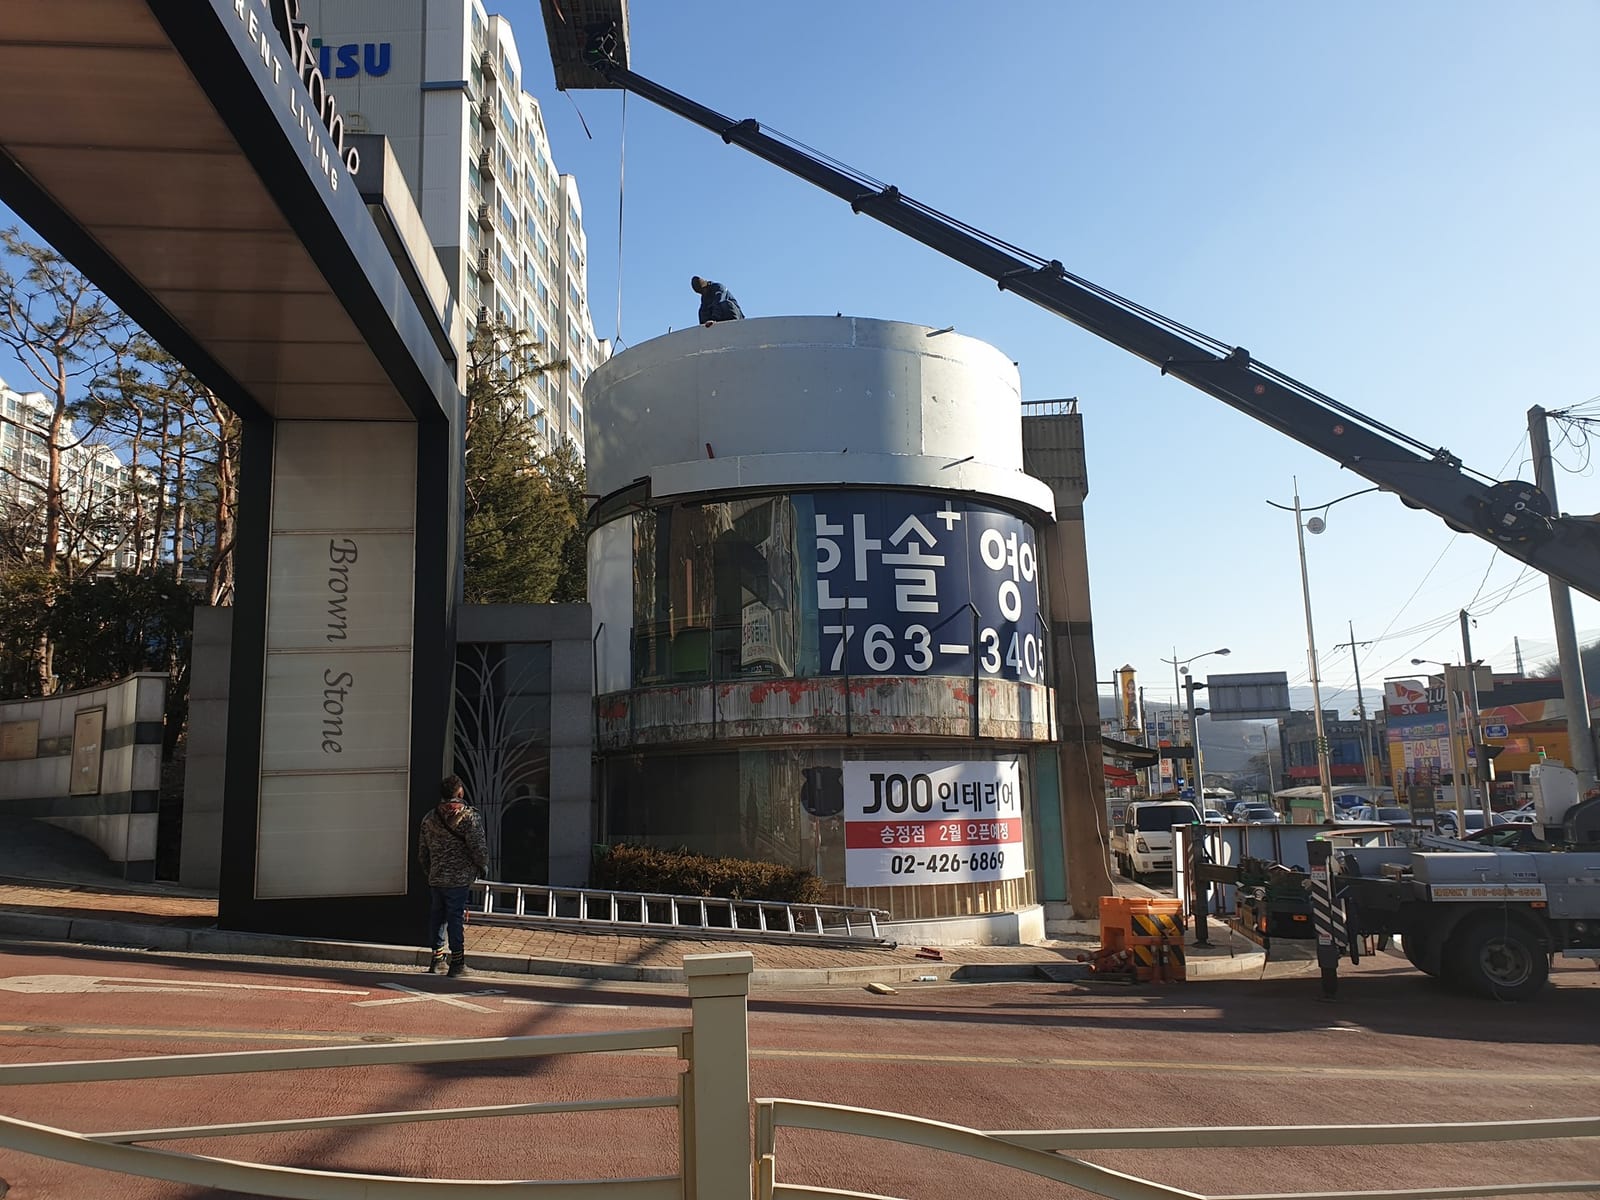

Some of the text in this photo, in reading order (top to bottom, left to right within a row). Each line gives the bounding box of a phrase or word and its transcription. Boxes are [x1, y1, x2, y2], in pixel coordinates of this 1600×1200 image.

[318, 42, 391, 80] ISU
[290, 87, 339, 192] LIVING
[321, 538, 359, 754] Brown Stone
[822, 623, 1046, 681] 763-3405
[1401, 704, 1418, 715] SK
[880, 822, 1009, 844] 송정점 2월 오픈예정
[891, 851, 1005, 875] 02-426-6869
